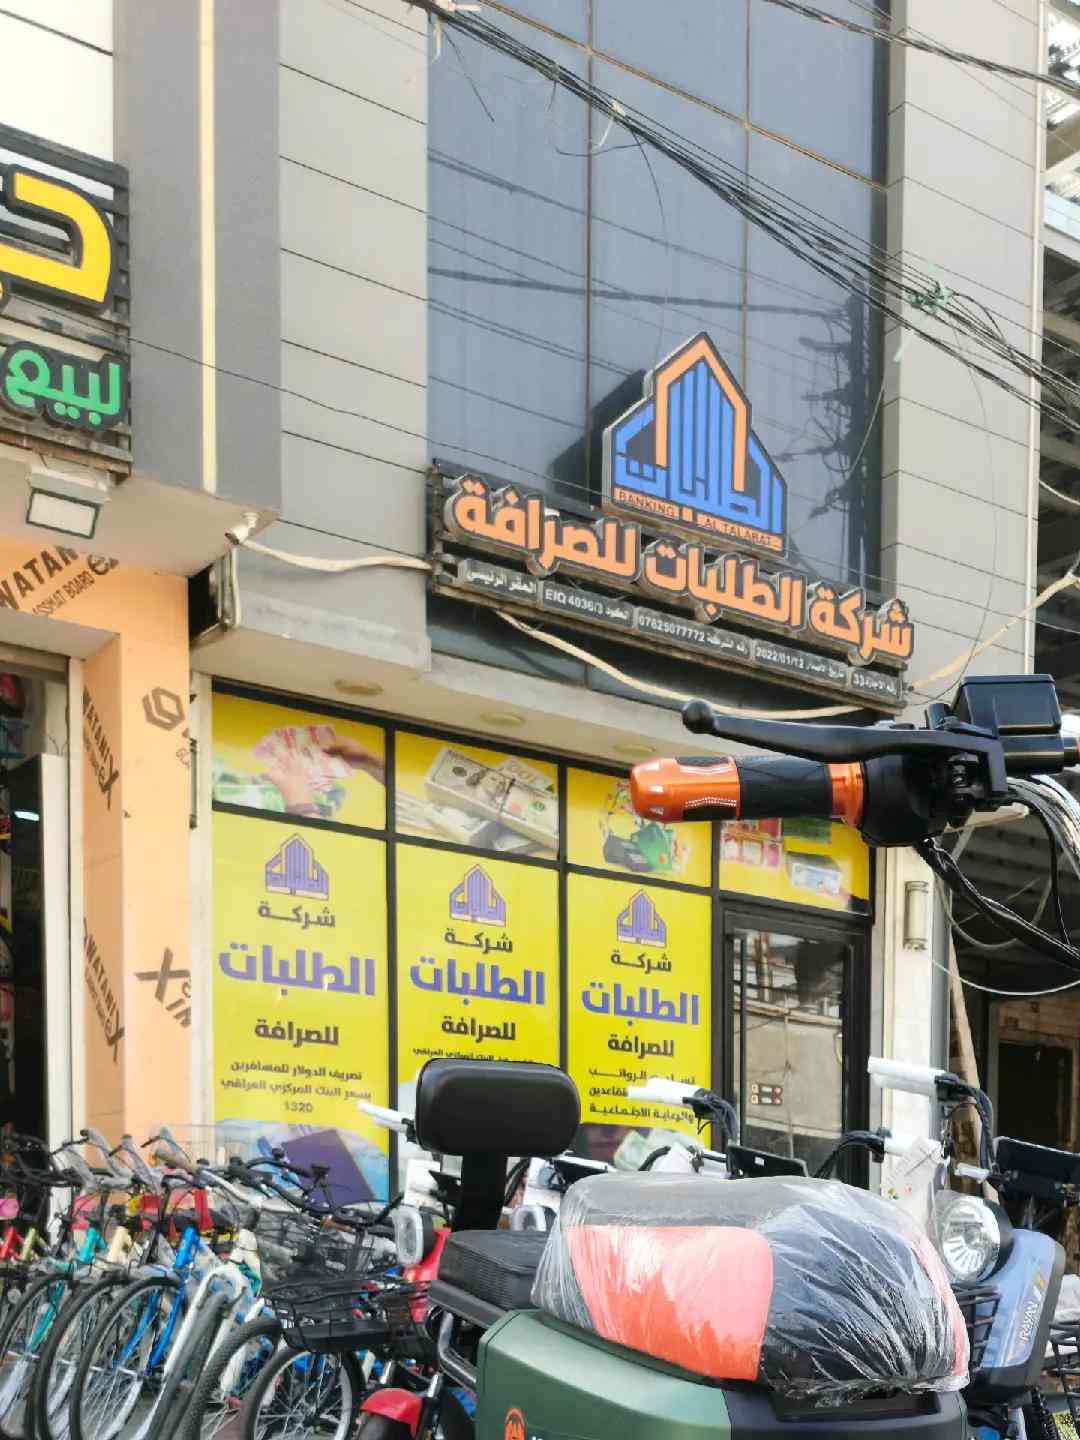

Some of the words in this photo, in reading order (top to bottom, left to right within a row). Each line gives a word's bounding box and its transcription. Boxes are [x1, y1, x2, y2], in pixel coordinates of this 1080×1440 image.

[5, 349, 122, 427] لبيع
[454, 478, 637, 577] للصرافة
[645, 544, 803, 627] الطلبات
[808, 585, 913, 659] شركة
[258, 900, 336, 930] شركة
[444, 927, 514, 955] شركة
[610, 950, 672, 975] شركة
[218, 941, 376, 997] الطلبات
[409, 955, 545, 1007] الطلبات
[581, 981, 700, 1027] الطلبات
[254, 1017, 340, 1048] للصرافة
[441, 1015, 516, 1044] للصرافة
[607, 1033, 675, 1060] للصرافة
